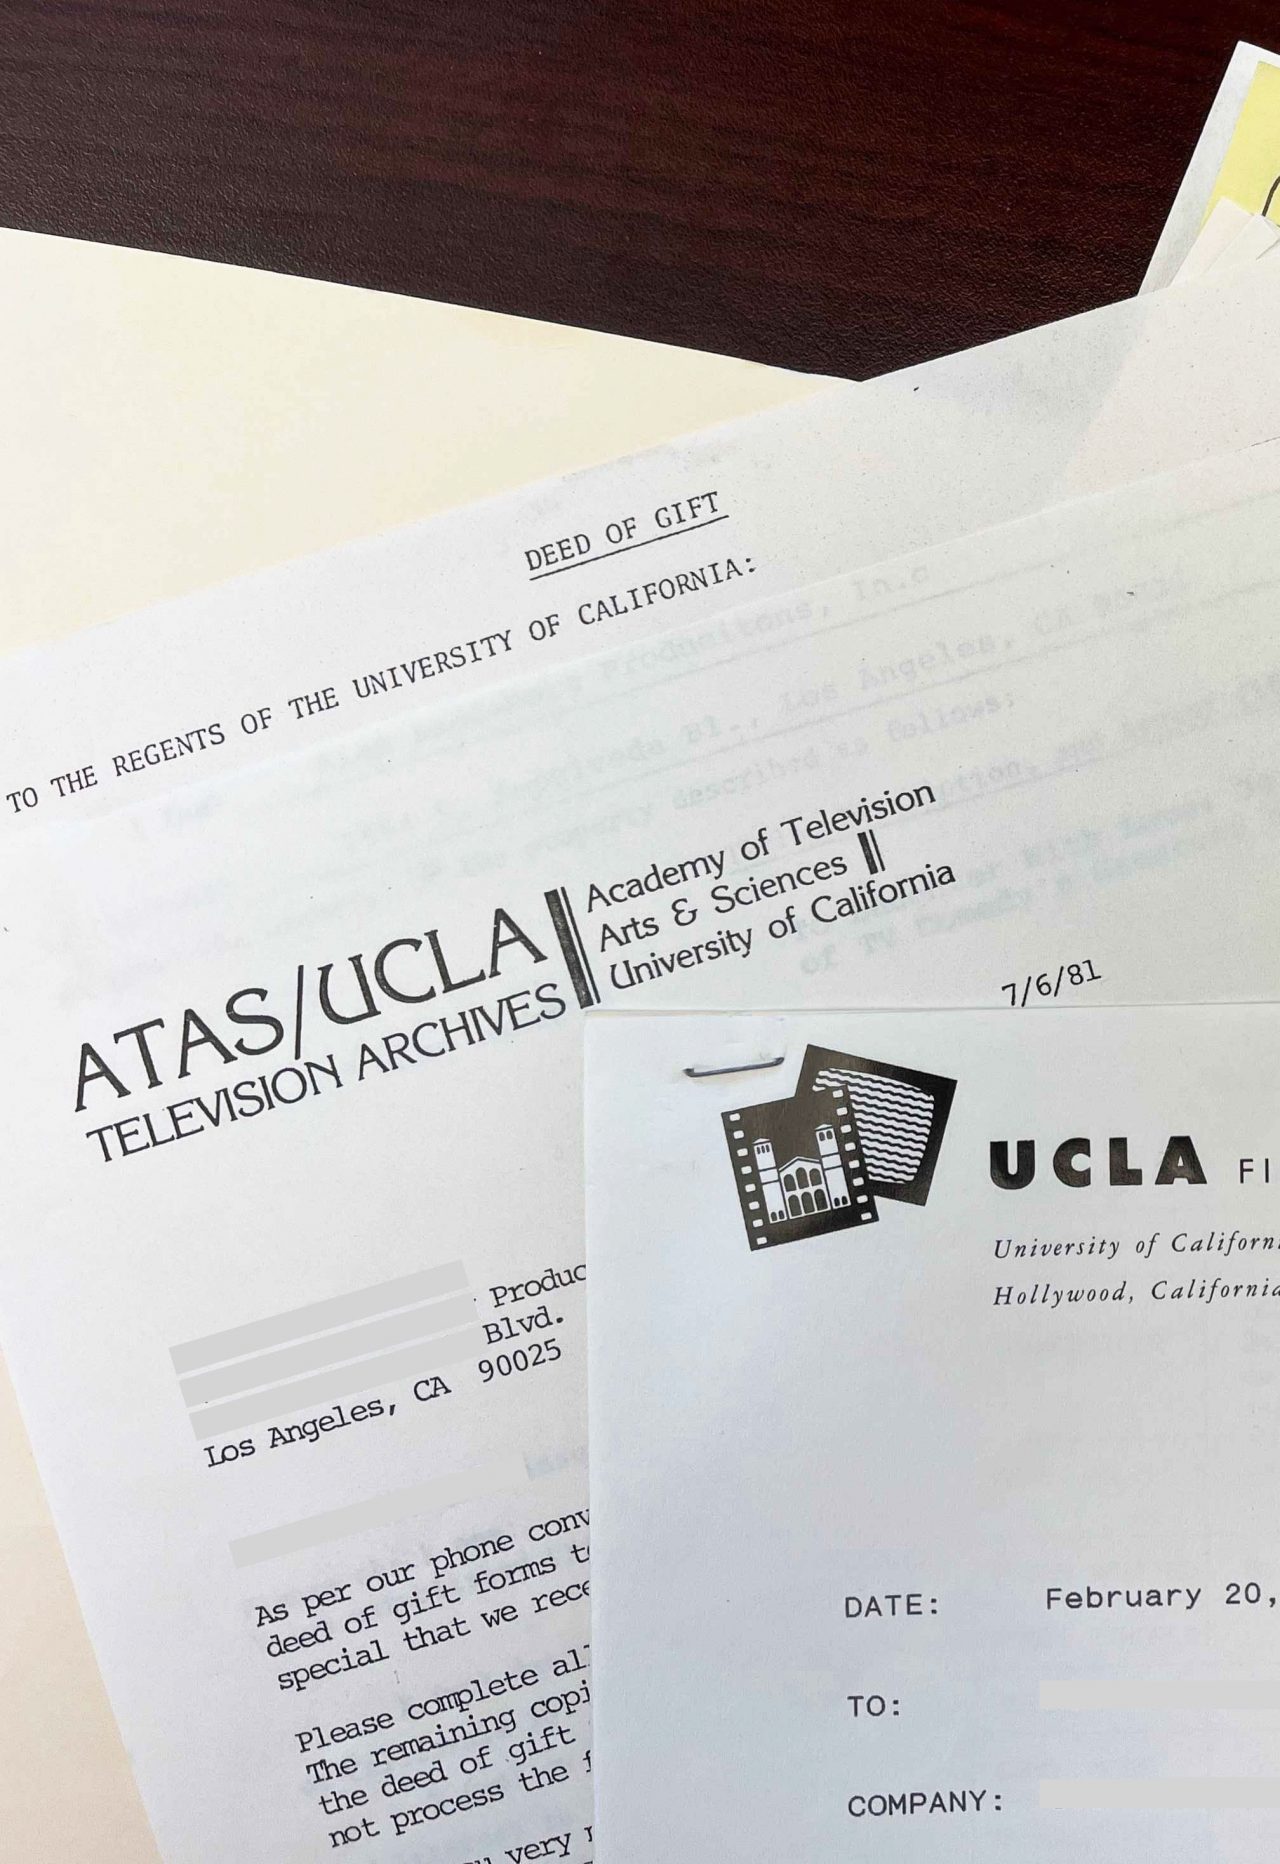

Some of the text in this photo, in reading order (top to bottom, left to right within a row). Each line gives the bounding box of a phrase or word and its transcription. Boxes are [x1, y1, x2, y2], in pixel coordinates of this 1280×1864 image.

[523, 489, 718, 569] DEED OF GIFT
[4, 556, 756, 814] TO THE REGENTS OF THE UNIVERSITY OF CALIFORNIA:
[586, 784, 937, 913] Academy of Television
[599, 855, 848, 953] Arts & Sciences
[608, 926, 753, 990] University
[767, 904, 798, 939] of
[809, 862, 957, 924] California
[73, 909, 549, 1113] ATAS/UCLA
[1000, 958, 1102, 1007] 7/6/81
[84, 981, 567, 1162] TELEVISION ARCHIVES
[988, 1134, 1208, 1191] UCLA
[487, 1262, 587, 1309] Produc
[993, 1234, 1120, 1260] University
[1134, 1231, 1161, 1259] of
[480, 1304, 564, 1345] Blvd.
[991, 1279, 1134, 1309] Hollywood,
[202, 1336, 562, 1468] Los Angeles, CA 90025
[253, 1601, 290, 1628] As
[299, 1582, 352, 1619] per
[365, 1562, 416, 1593] our
[427, 1533, 515, 1580] phone
[265, 1618, 334, 1658] deed
[343, 1603, 379, 1634] of
[391, 1583, 462, 1626] gift
[472, 1554, 557, 1595] forms
[843, 1592, 938, 1618] DATE:
[1045, 1584, 1202, 1610] February
[1224, 1580, 1276, 1608] 20,
[276, 1638, 390, 1693] special
[401, 1615, 472, 1652] that
[478, 1604, 519, 1628] we
[293, 1711, 396, 1754] Please
[406, 1667, 540, 1721] complete
[304, 1756, 359, 1785] The
[368, 1707, 517, 1768] remaining
[845, 1693, 900, 1718] TO:
[317, 1724, 577, 1815] the deed of gift
[327, 1816, 381, 1849] not
[388, 1782, 505, 1837] process
[517, 1764, 570, 1792] the
[846, 1788, 1002, 1818] COMPANY:
[504, 1831, 572, 1864] very
